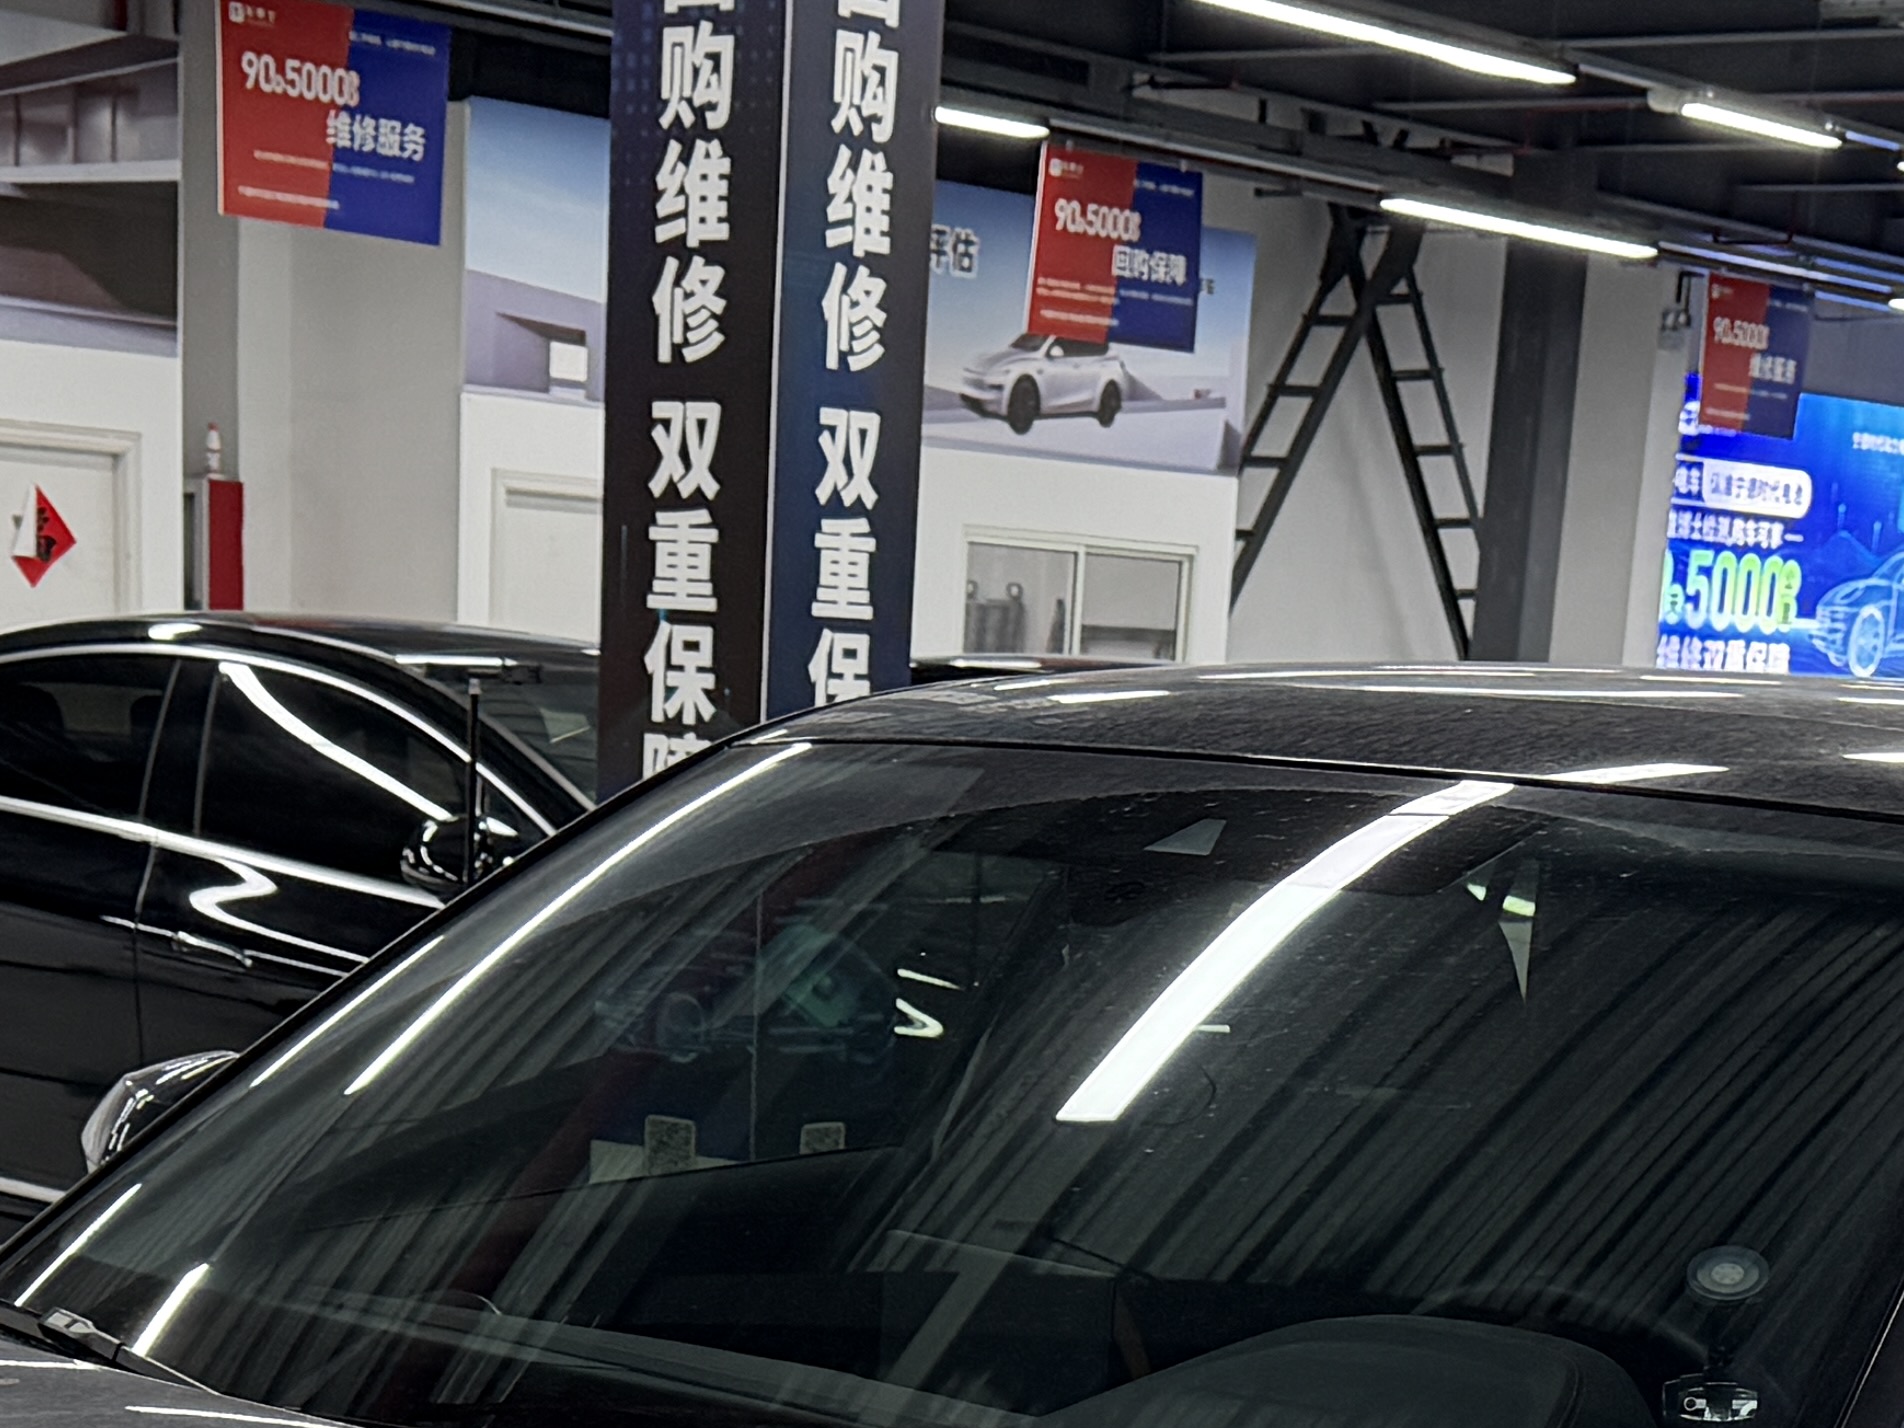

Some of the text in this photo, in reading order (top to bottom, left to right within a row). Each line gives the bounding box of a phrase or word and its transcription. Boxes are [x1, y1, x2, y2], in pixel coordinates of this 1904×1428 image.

[326, 109, 426, 162] 维修服务
[652, 0, 736, 364] 购维修
[808, 0, 900, 705] 购维修 双重保
